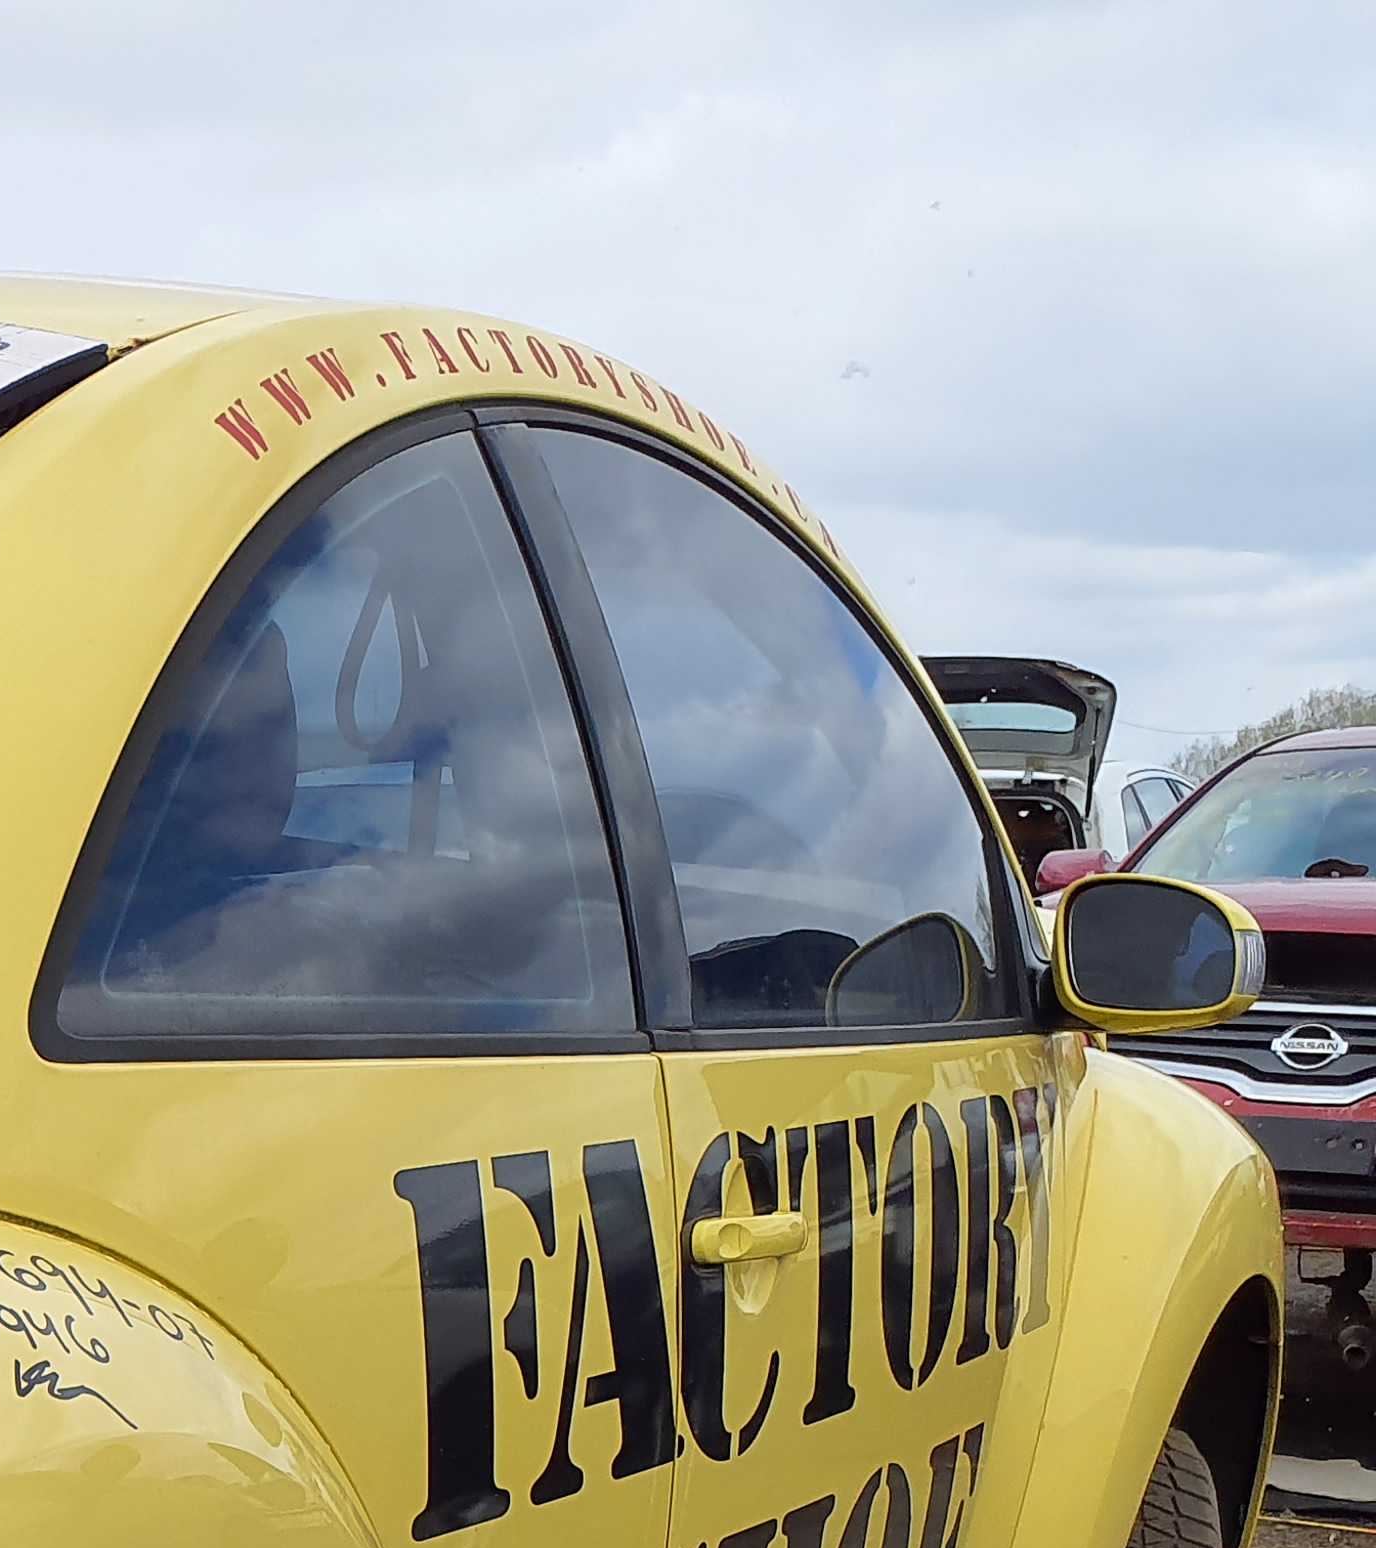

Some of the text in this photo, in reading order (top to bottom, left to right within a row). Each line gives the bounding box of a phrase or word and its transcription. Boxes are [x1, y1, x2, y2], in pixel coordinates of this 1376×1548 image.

[214, 326, 841, 561] WWW.FACTORYSHOE.CA
[1279, 1040, 1339, 1052] NISSAN
[392, 1083, 1057, 1542] FACTORY
